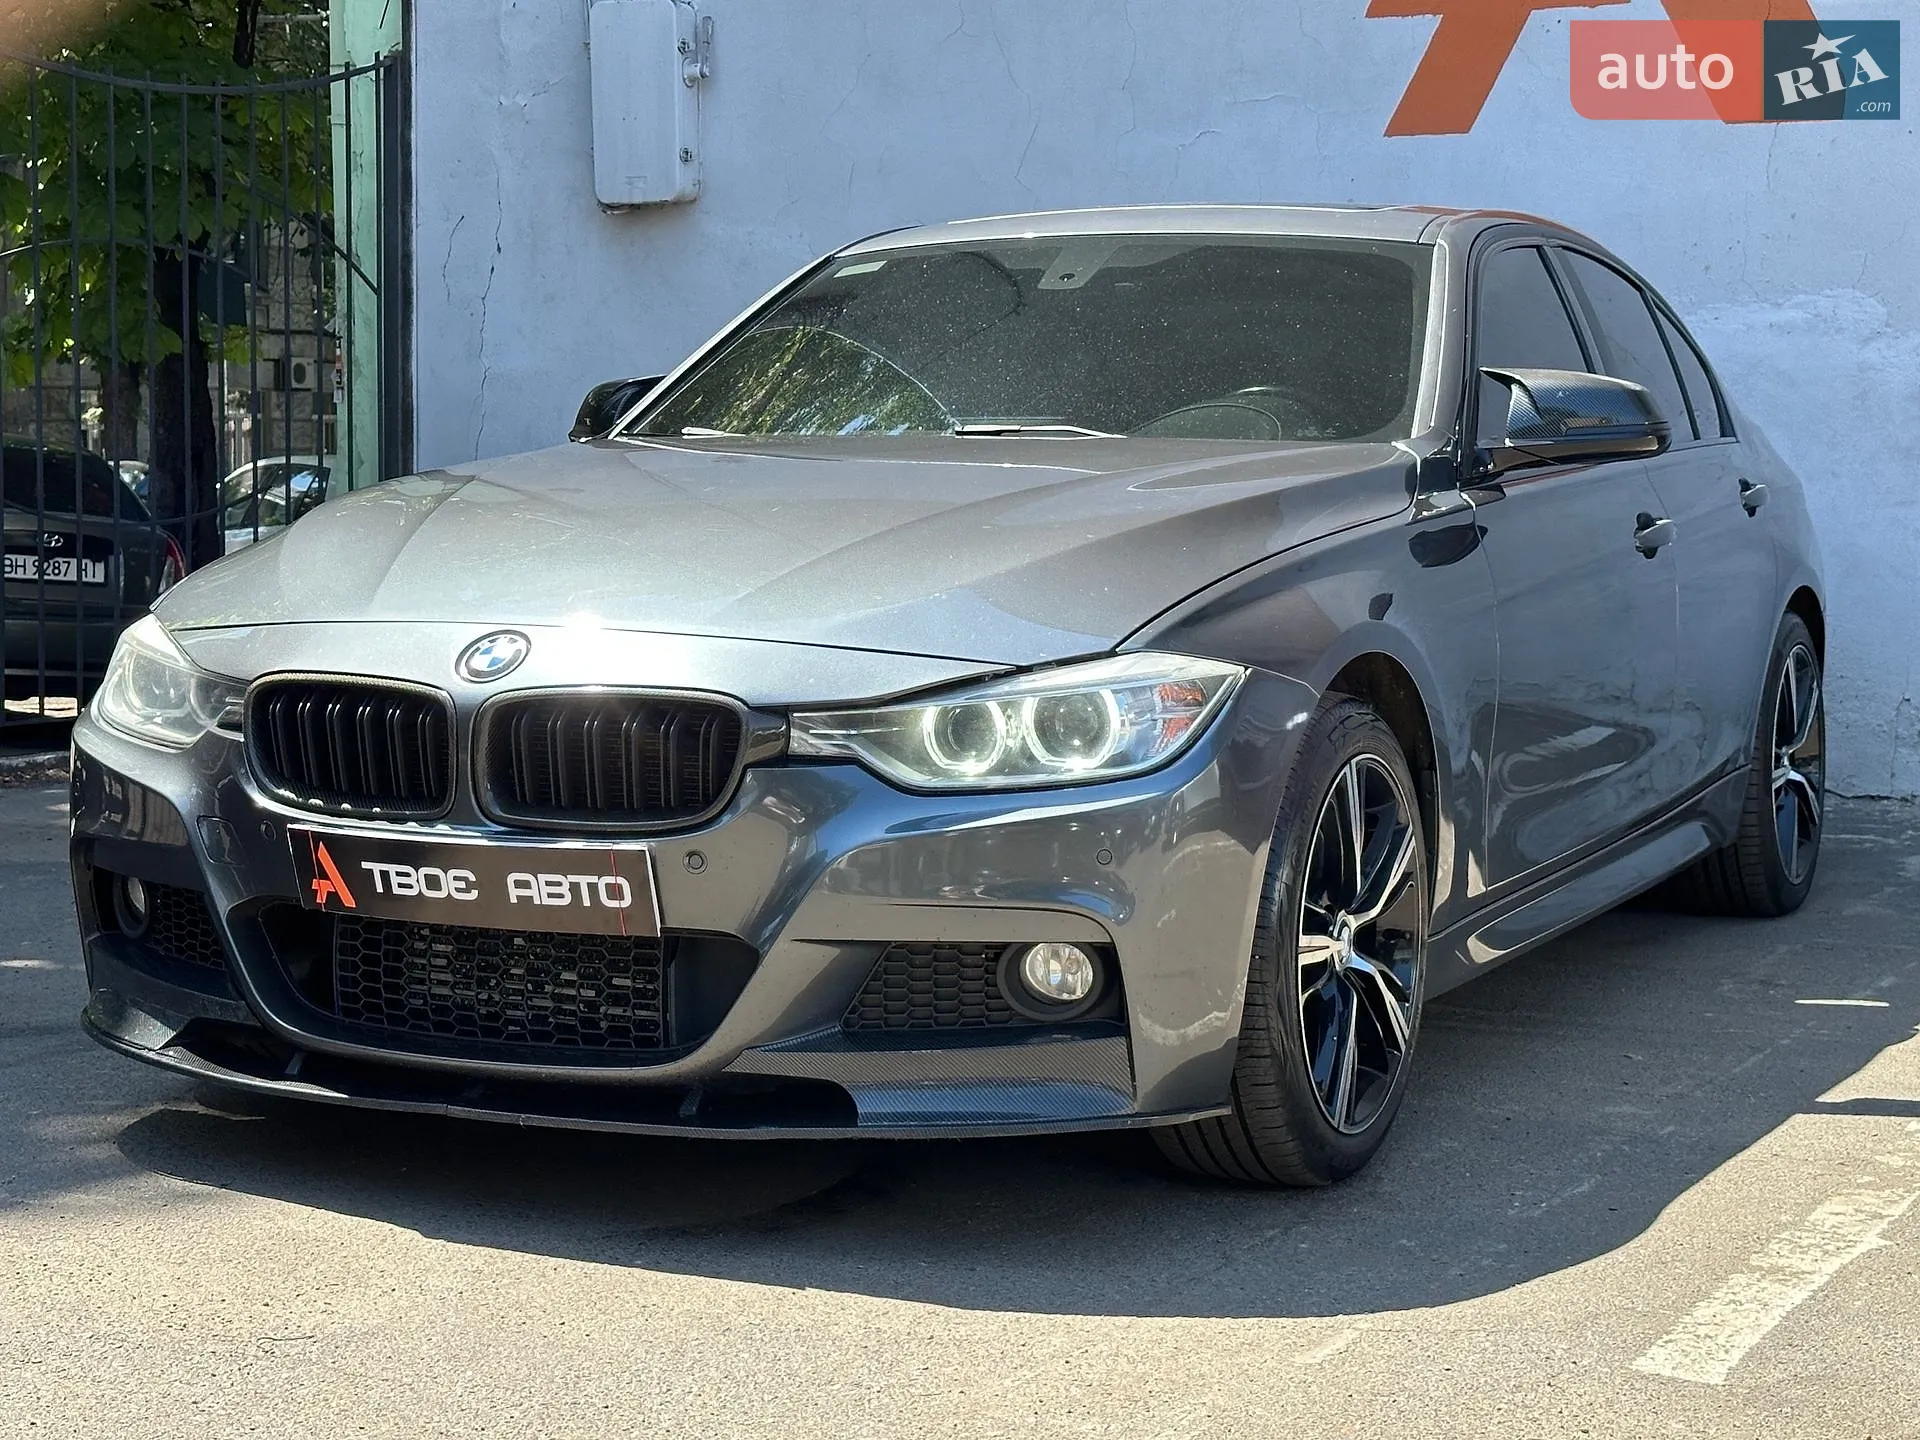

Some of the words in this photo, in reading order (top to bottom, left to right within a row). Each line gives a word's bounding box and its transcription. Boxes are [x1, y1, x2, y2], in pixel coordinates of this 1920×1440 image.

[32, 558, 71, 578] 9287
[360, 861, 479, 902] ТВОЄ
[505, 872, 633, 909] АВТО
